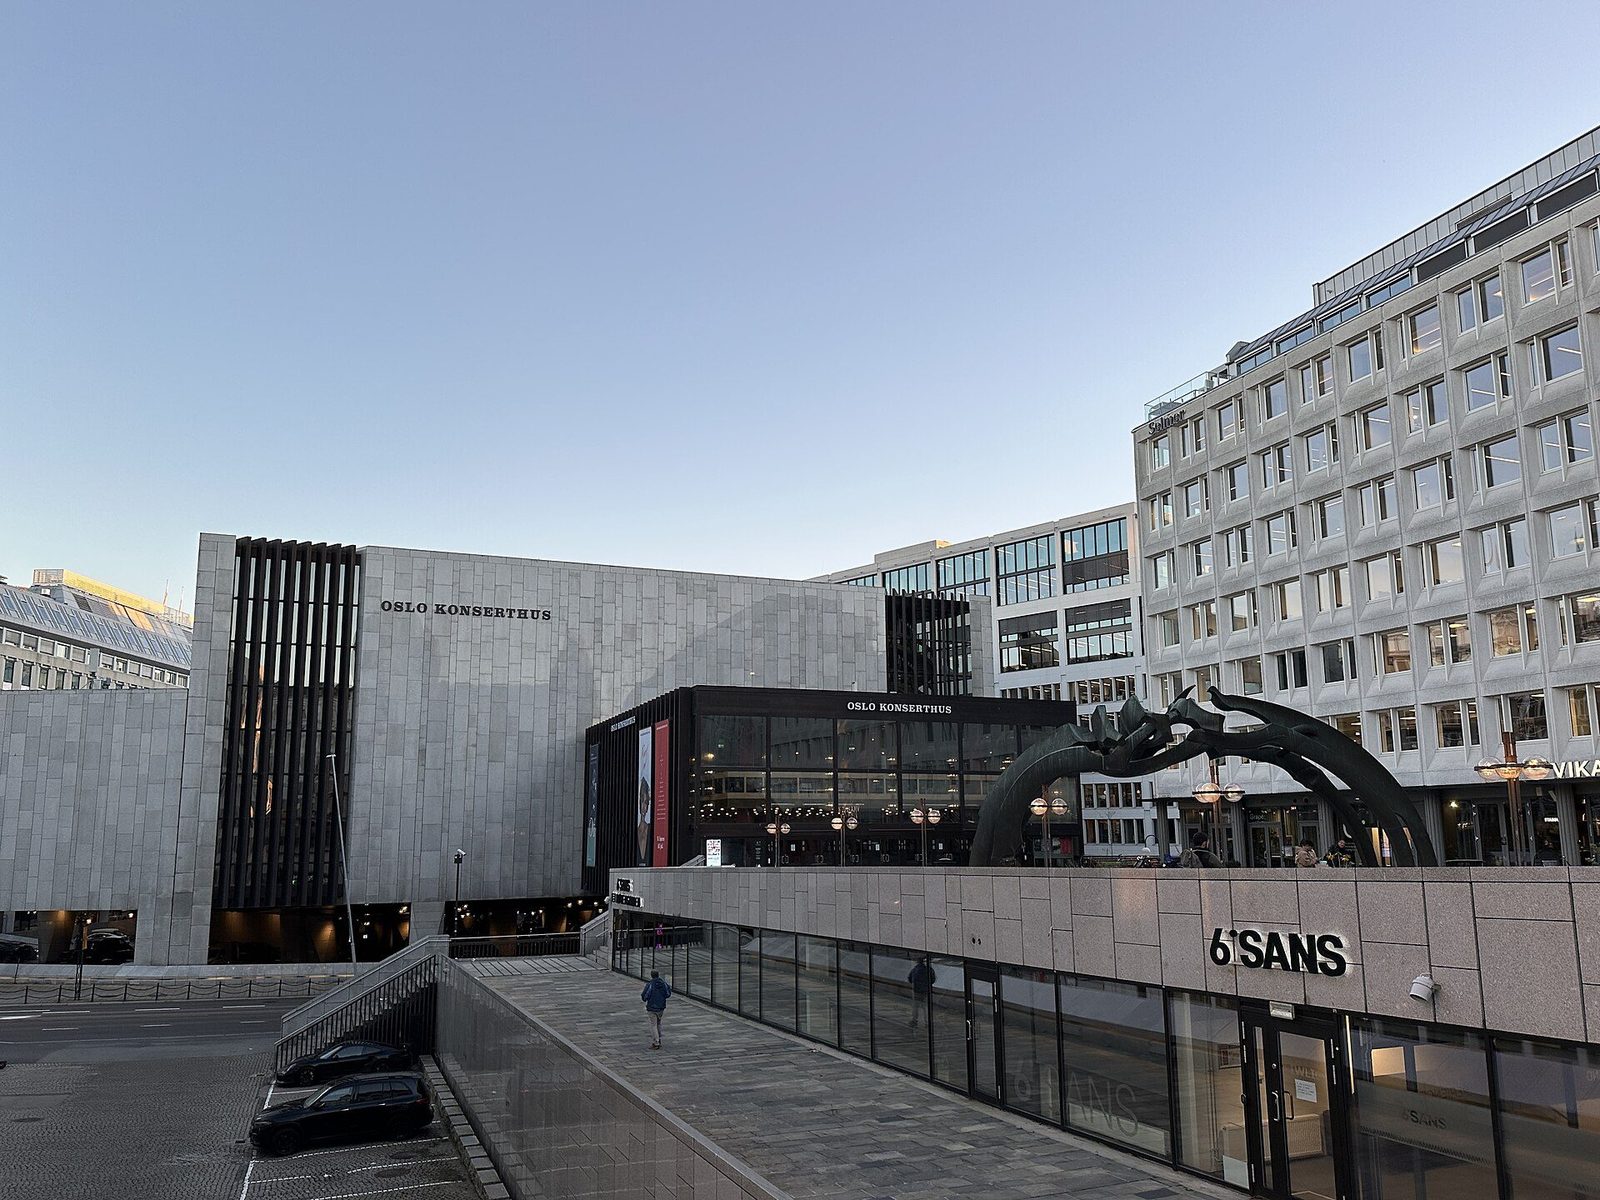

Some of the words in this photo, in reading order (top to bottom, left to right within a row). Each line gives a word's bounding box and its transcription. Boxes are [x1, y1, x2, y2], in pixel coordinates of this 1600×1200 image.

[1148, 409, 1186, 435] Selmer
[381, 600, 428, 614] OSLO
[434, 603, 552, 621] KONSERTHUS
[847, 701, 876, 711] OSLO
[879, 703, 952, 714] KONSERTHUS
